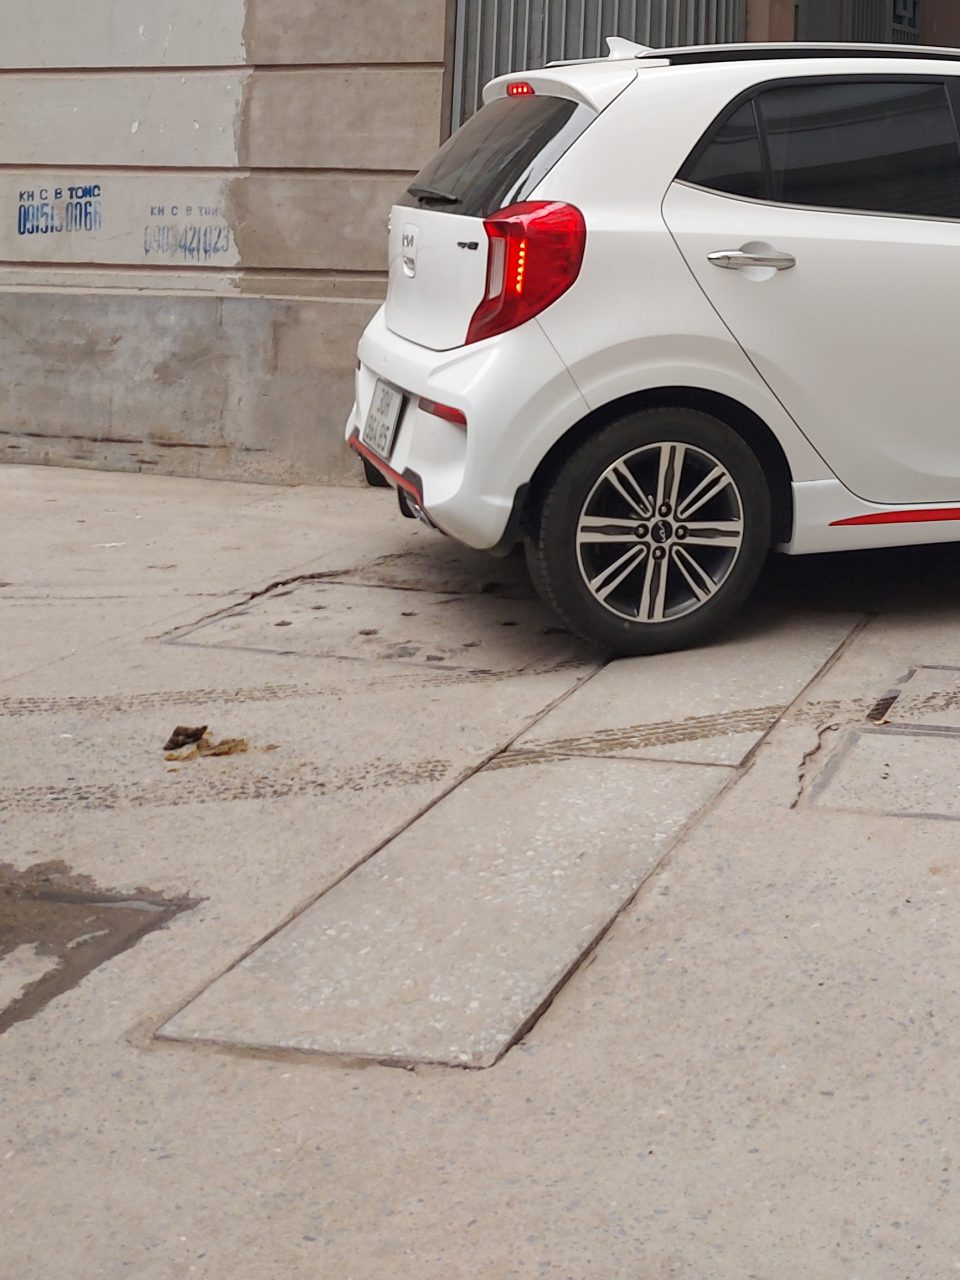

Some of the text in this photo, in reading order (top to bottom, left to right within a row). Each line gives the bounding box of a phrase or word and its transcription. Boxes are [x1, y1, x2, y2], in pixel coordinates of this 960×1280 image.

[19, 191, 34, 202] KH
[40, 188, 48, 200] C
[54, 187, 63, 200] B
[150, 206, 165, 216] KH
[171, 206, 179, 216] C
